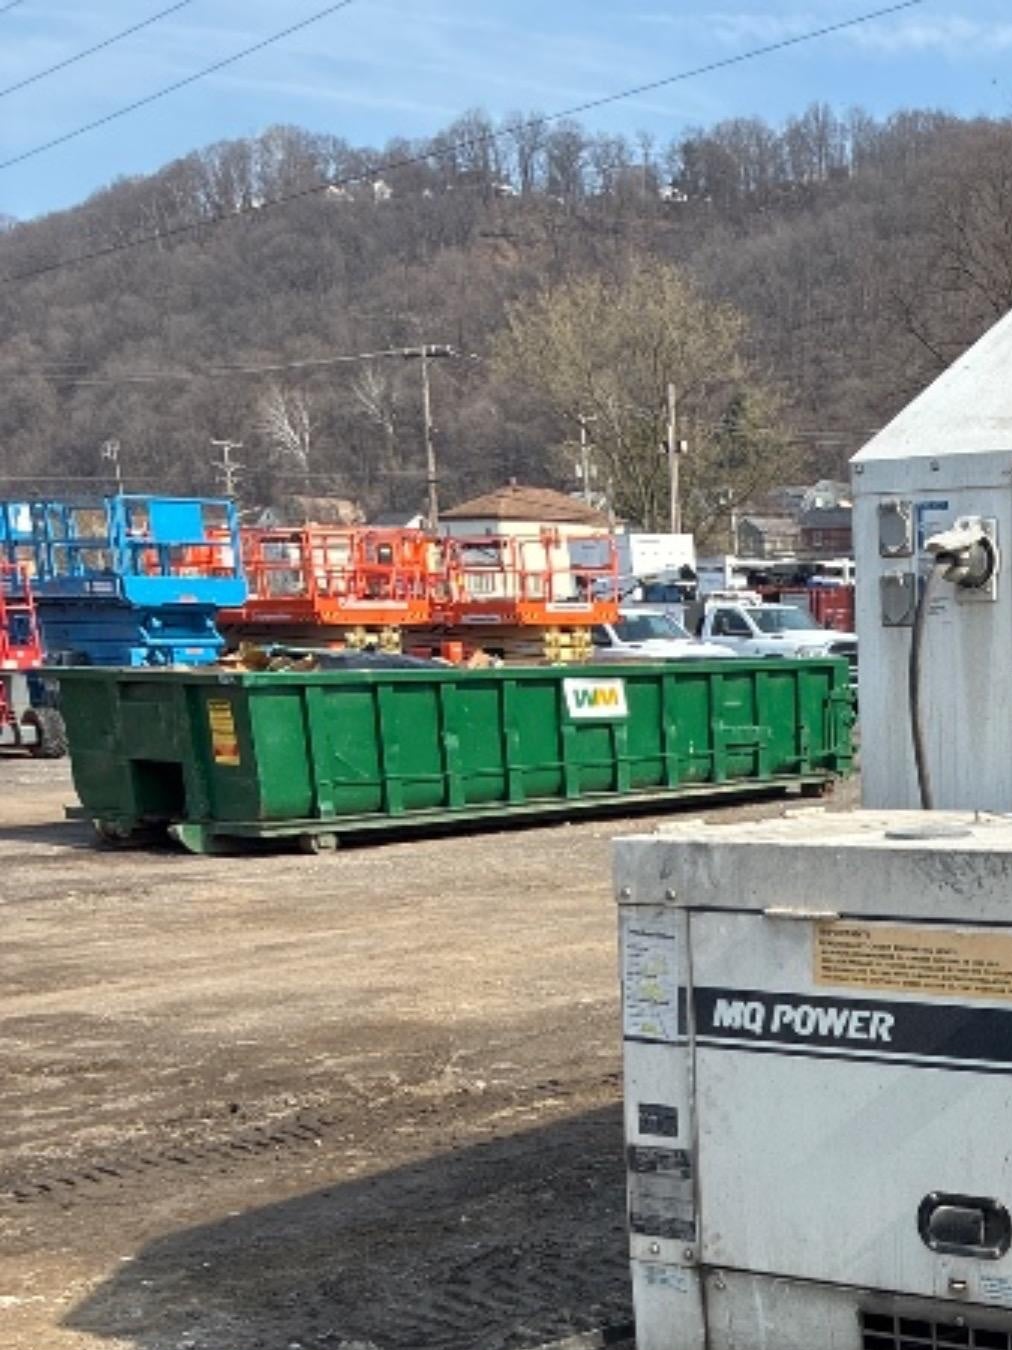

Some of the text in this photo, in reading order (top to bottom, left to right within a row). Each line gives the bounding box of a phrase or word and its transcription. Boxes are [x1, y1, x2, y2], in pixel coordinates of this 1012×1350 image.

[573, 688, 618, 708] WM
[713, 999, 766, 1035] MQ
[770, 1004, 895, 1042] POWER
